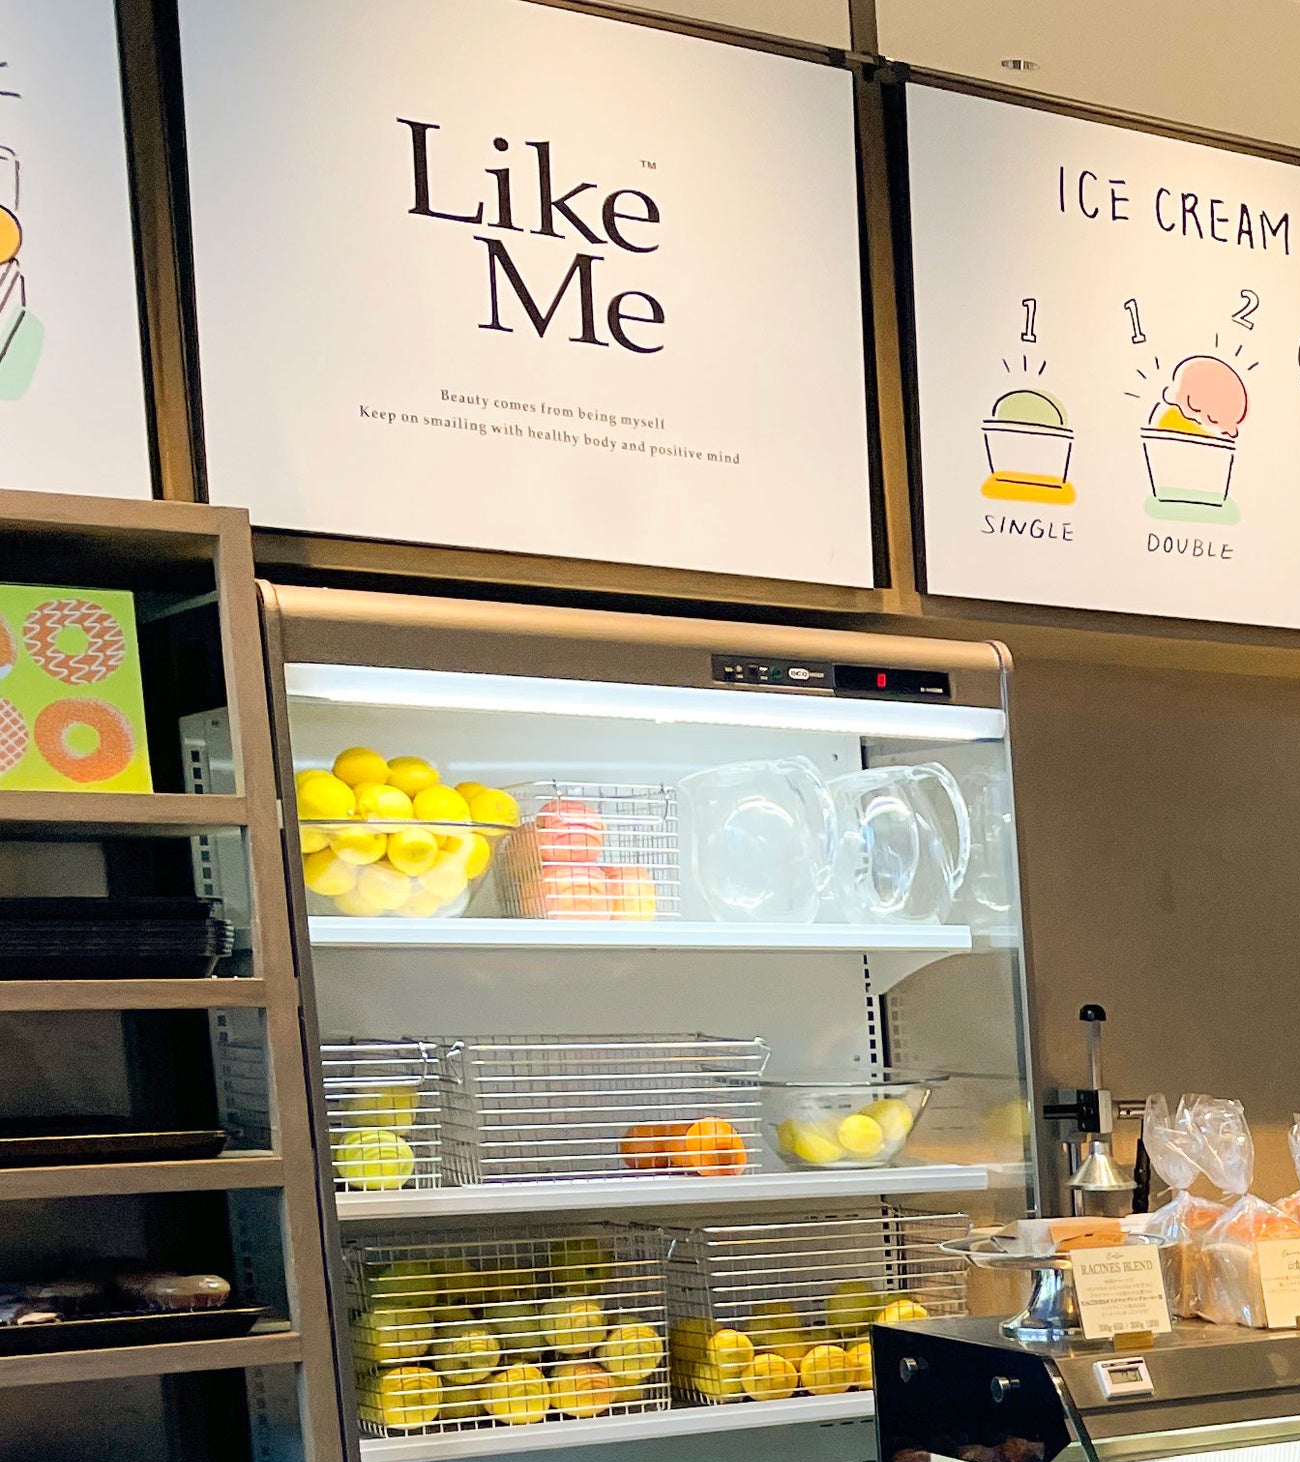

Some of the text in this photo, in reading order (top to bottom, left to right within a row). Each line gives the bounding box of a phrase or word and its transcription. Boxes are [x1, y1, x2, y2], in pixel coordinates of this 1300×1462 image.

[395, 117, 662, 254] Like
[640, 160, 657, 171] TM
[1058, 165, 1292, 256] ICE CREAM
[473, 235, 666, 354] Me
[1232, 288, 1260, 330] 2
[1021, 298, 1038, 343] 1
[1123, 298, 1147, 344] 1
[440, 389, 665, 432] Beauty comes from being myself
[359, 404, 741, 465] Keep on smailing with healthy body and positive mind
[980, 513, 1075, 544] SINGLE
[1146, 532, 1234, 561] DOUBLE
[1080, 1260, 1153, 1276] RACINES BLEND
